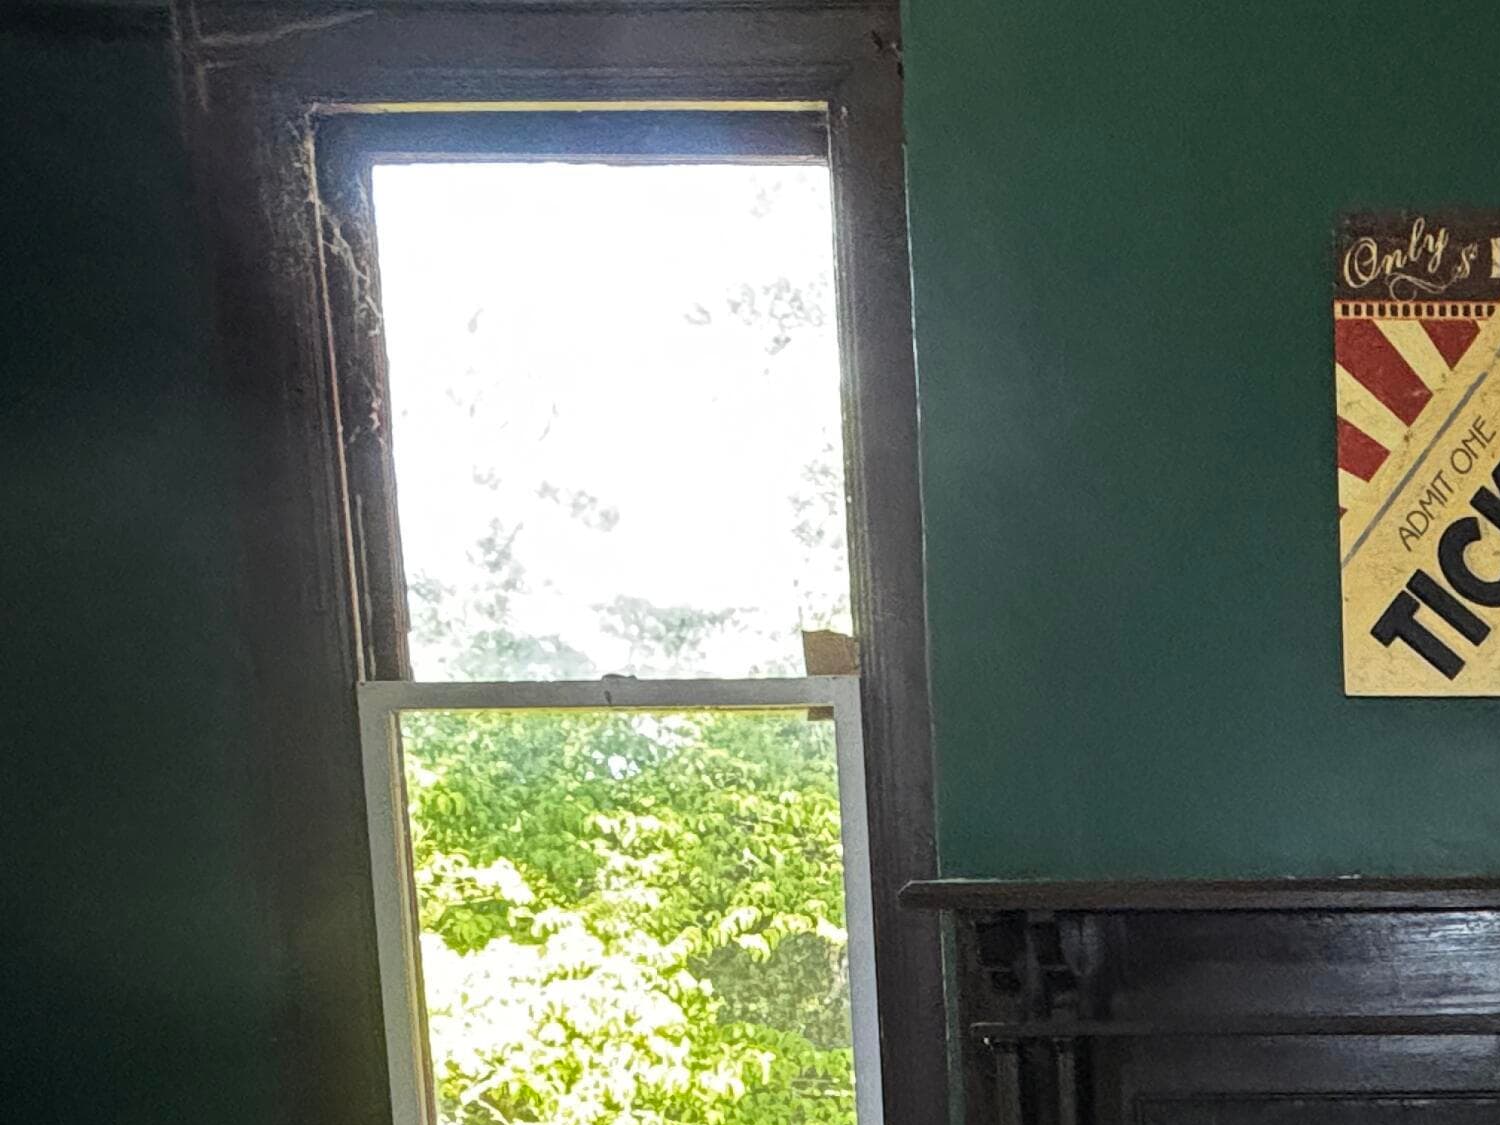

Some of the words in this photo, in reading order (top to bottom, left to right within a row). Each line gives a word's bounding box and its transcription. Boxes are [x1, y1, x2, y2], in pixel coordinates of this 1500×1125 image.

[1343, 217, 1449, 301] Only
[1398, 470, 1454, 552] ADMIT
[1450, 415, 1497, 476] ONE
